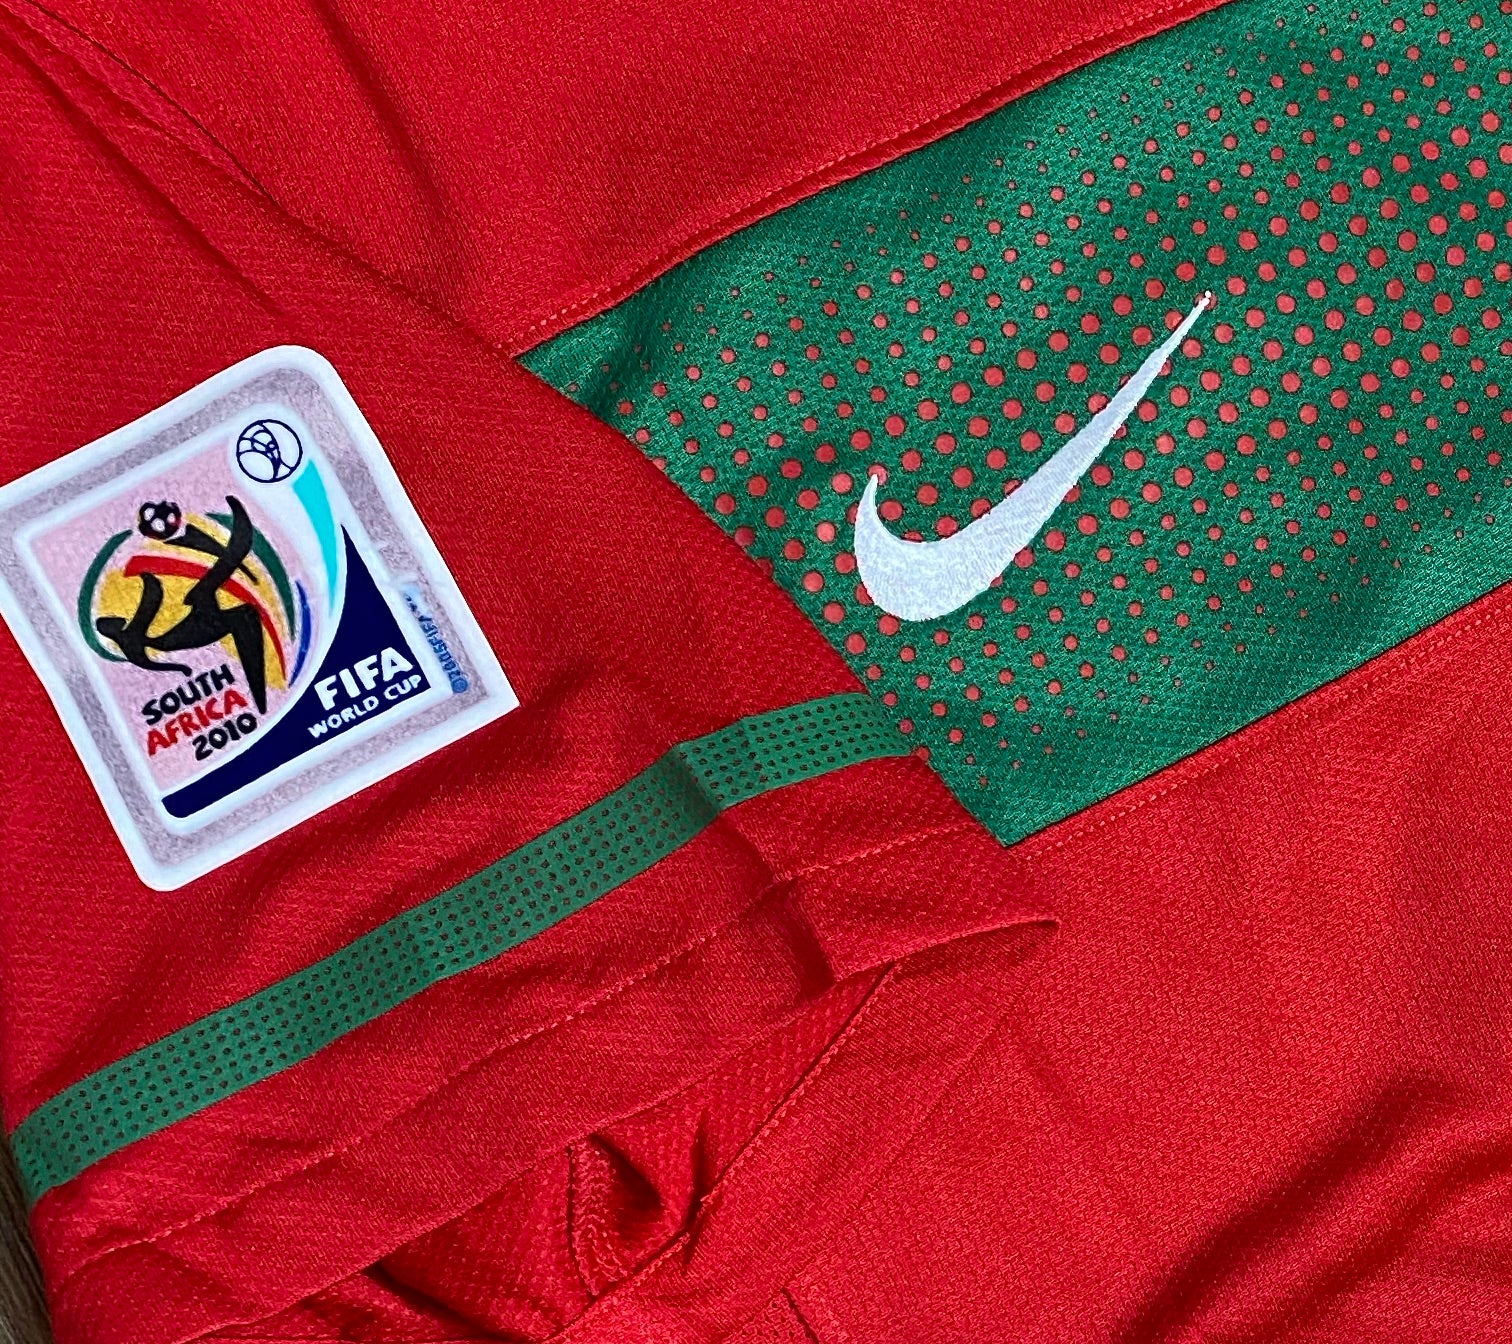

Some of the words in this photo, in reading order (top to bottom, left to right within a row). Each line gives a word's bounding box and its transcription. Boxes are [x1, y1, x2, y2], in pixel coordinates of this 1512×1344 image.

[141, 663, 236, 725] SOUTH
[307, 694, 380, 739] WORLD
[384, 674, 422, 701] CUP
[314, 646, 414, 710] FIFA
[147, 690, 249, 755] AFRICA
[192, 712, 258, 761] 2010
